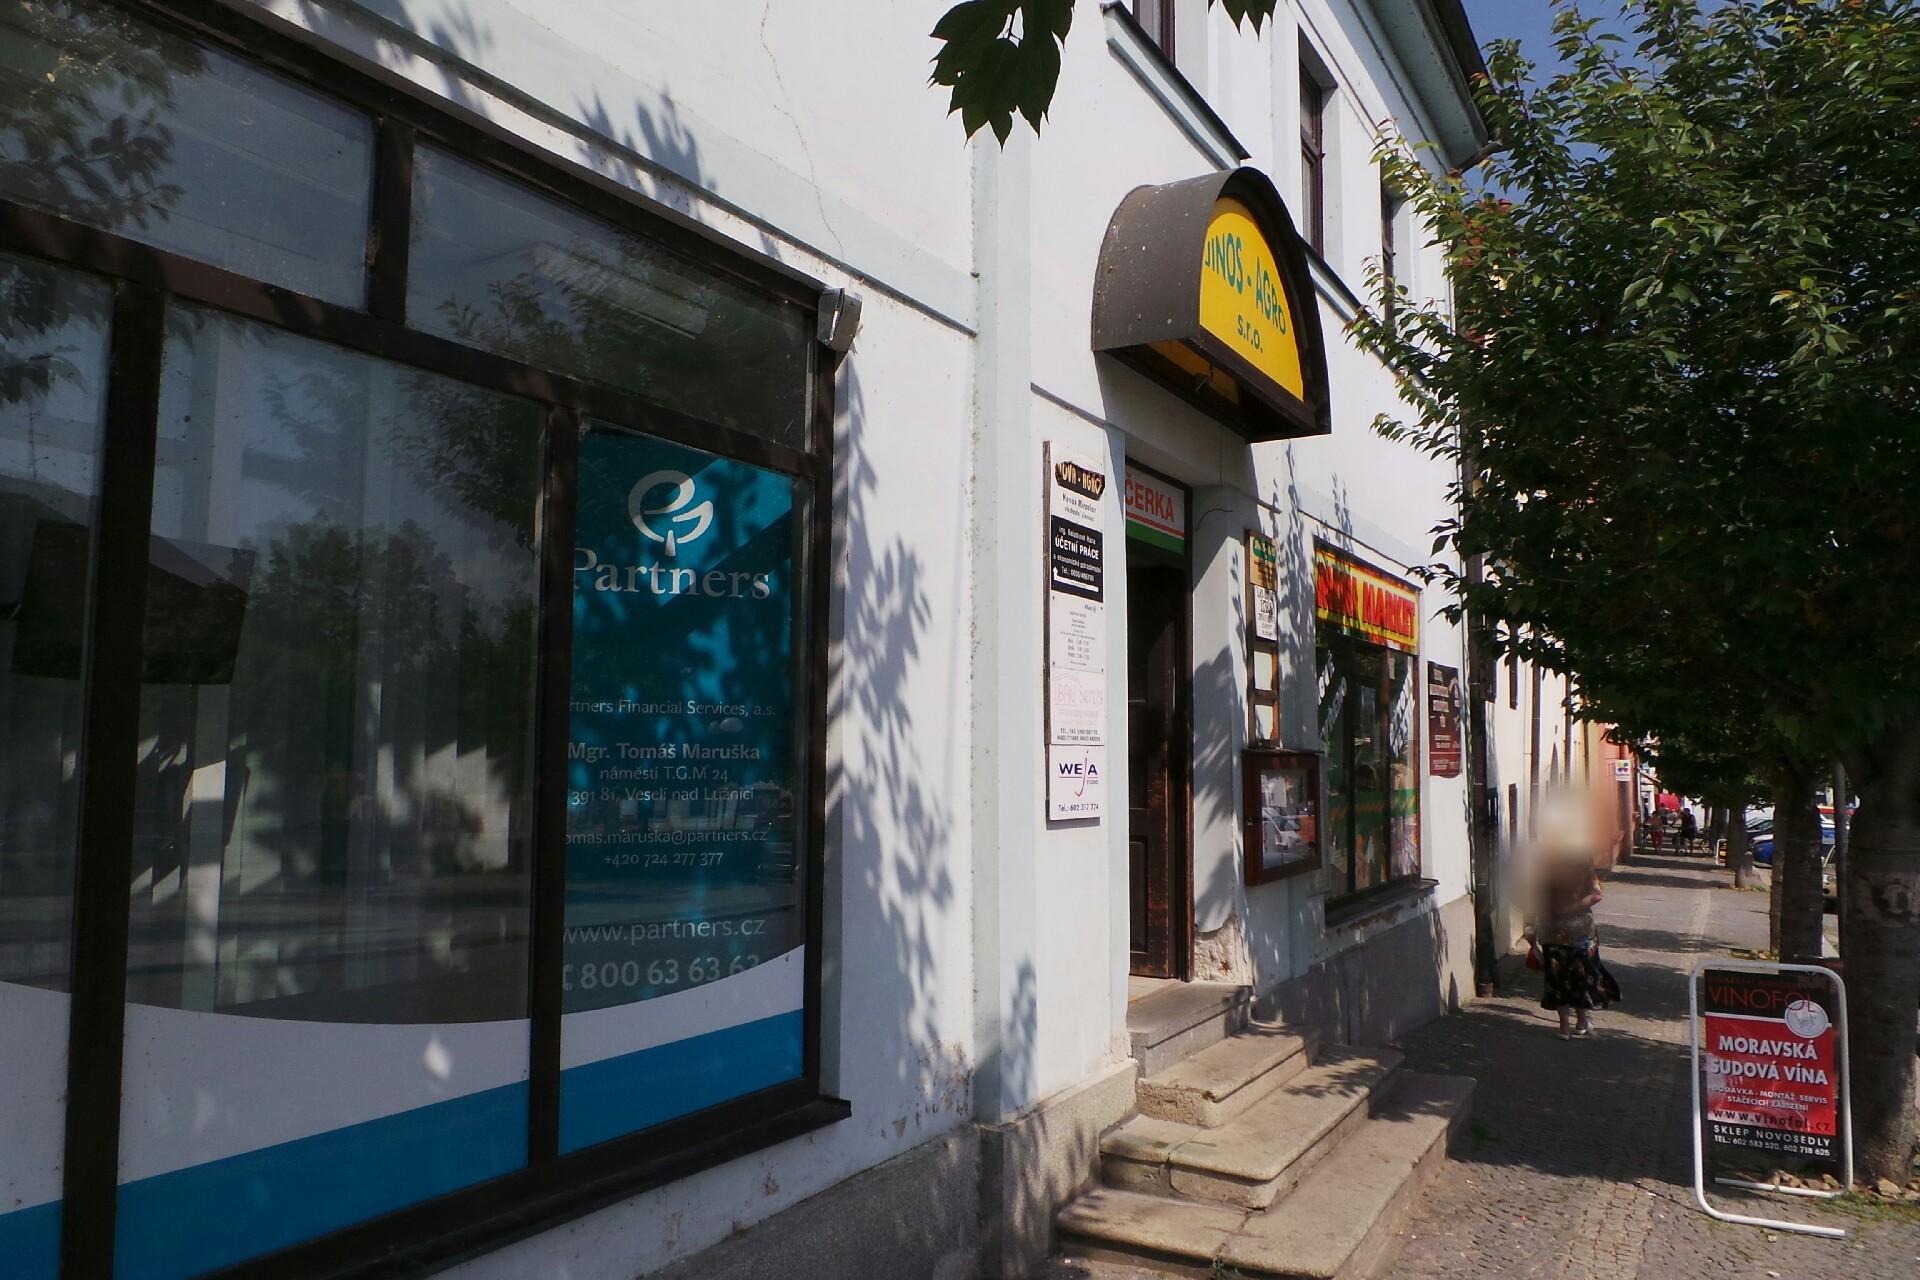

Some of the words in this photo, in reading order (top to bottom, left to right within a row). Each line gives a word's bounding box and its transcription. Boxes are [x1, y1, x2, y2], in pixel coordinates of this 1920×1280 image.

[1204, 232, 1244, 295] JINOS
[1255, 256, 1287, 335] AGRO
[1236, 313, 1264, 354] s.r.o.
[1055, 534, 1078, 554] ÚČETNÍ
[1079, 544, 1099, 560] PRÁCE
[574, 548, 771, 600] Partners
[1363, 581, 1416, 640] MARKET
[618, 699, 682, 714] Financial
[687, 700, 749, 717] Services,
[567, 742, 610, 763] Mgr.
[616, 743, 676, 759] Tomáš
[682, 743, 760, 760] Maruška
[712, 769, 728, 782] 24
[672, 787, 699, 801] nad
[604, 853, 639, 868] +420
[643, 853, 668, 868] 724
[673, 852, 696, 865] 277
[700, 852, 724, 866] 377
[563, 918, 766, 945] www.partners.cz
[580, 961, 639, 989] 800
[647, 959, 679, 985] 63
[688, 956, 720, 982] 63
[1708, 984, 1816, 1013] VINOFOL
[1718, 1034, 1818, 1060] MORAVSKÁ
[1711, 1059, 1781, 1081] SUDOVÁ
[1783, 1062, 1829, 1086] VÍNA
[1713, 1124, 1750, 1136] SKLEP
[1756, 1130, 1831, 1148] NOVOSEDLY
